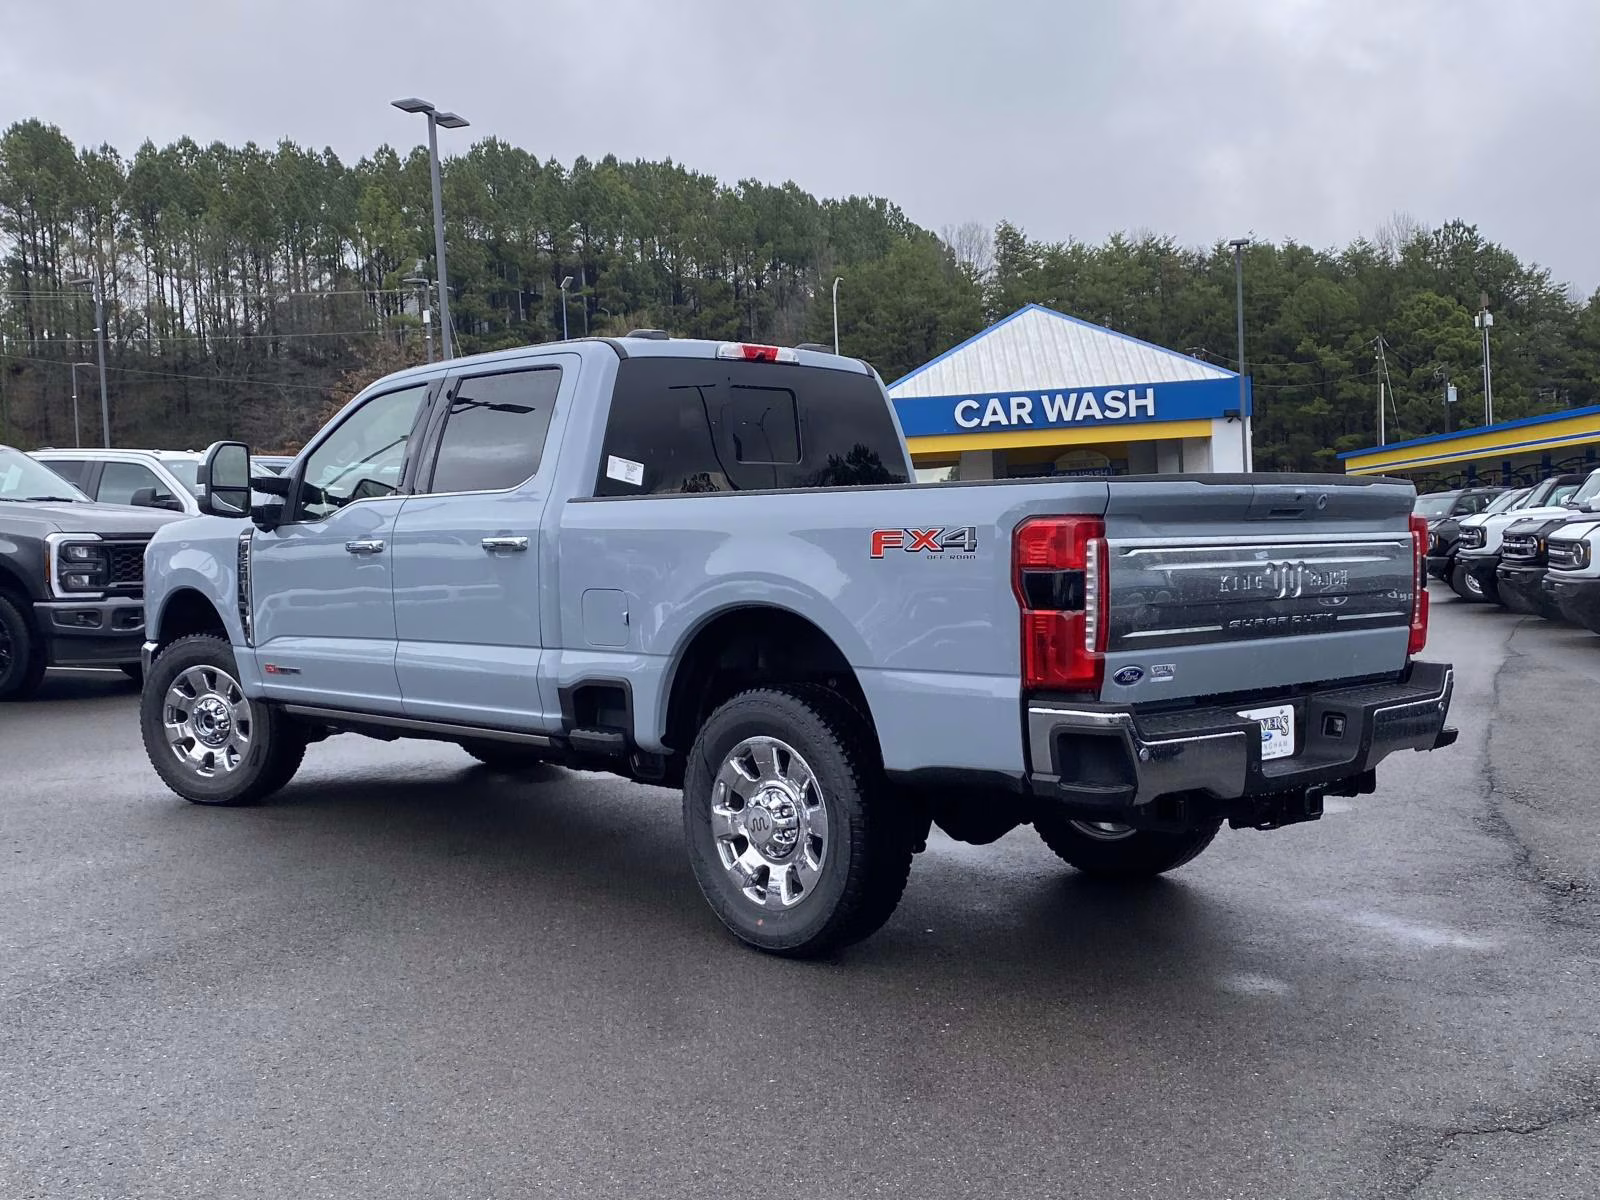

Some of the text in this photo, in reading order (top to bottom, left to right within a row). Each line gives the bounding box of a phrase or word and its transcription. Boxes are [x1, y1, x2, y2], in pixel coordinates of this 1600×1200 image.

[954, 388, 1155, 428] CAR WASH
[870, 527, 977, 559] FX4
[1219, 575, 1263, 592] KING
